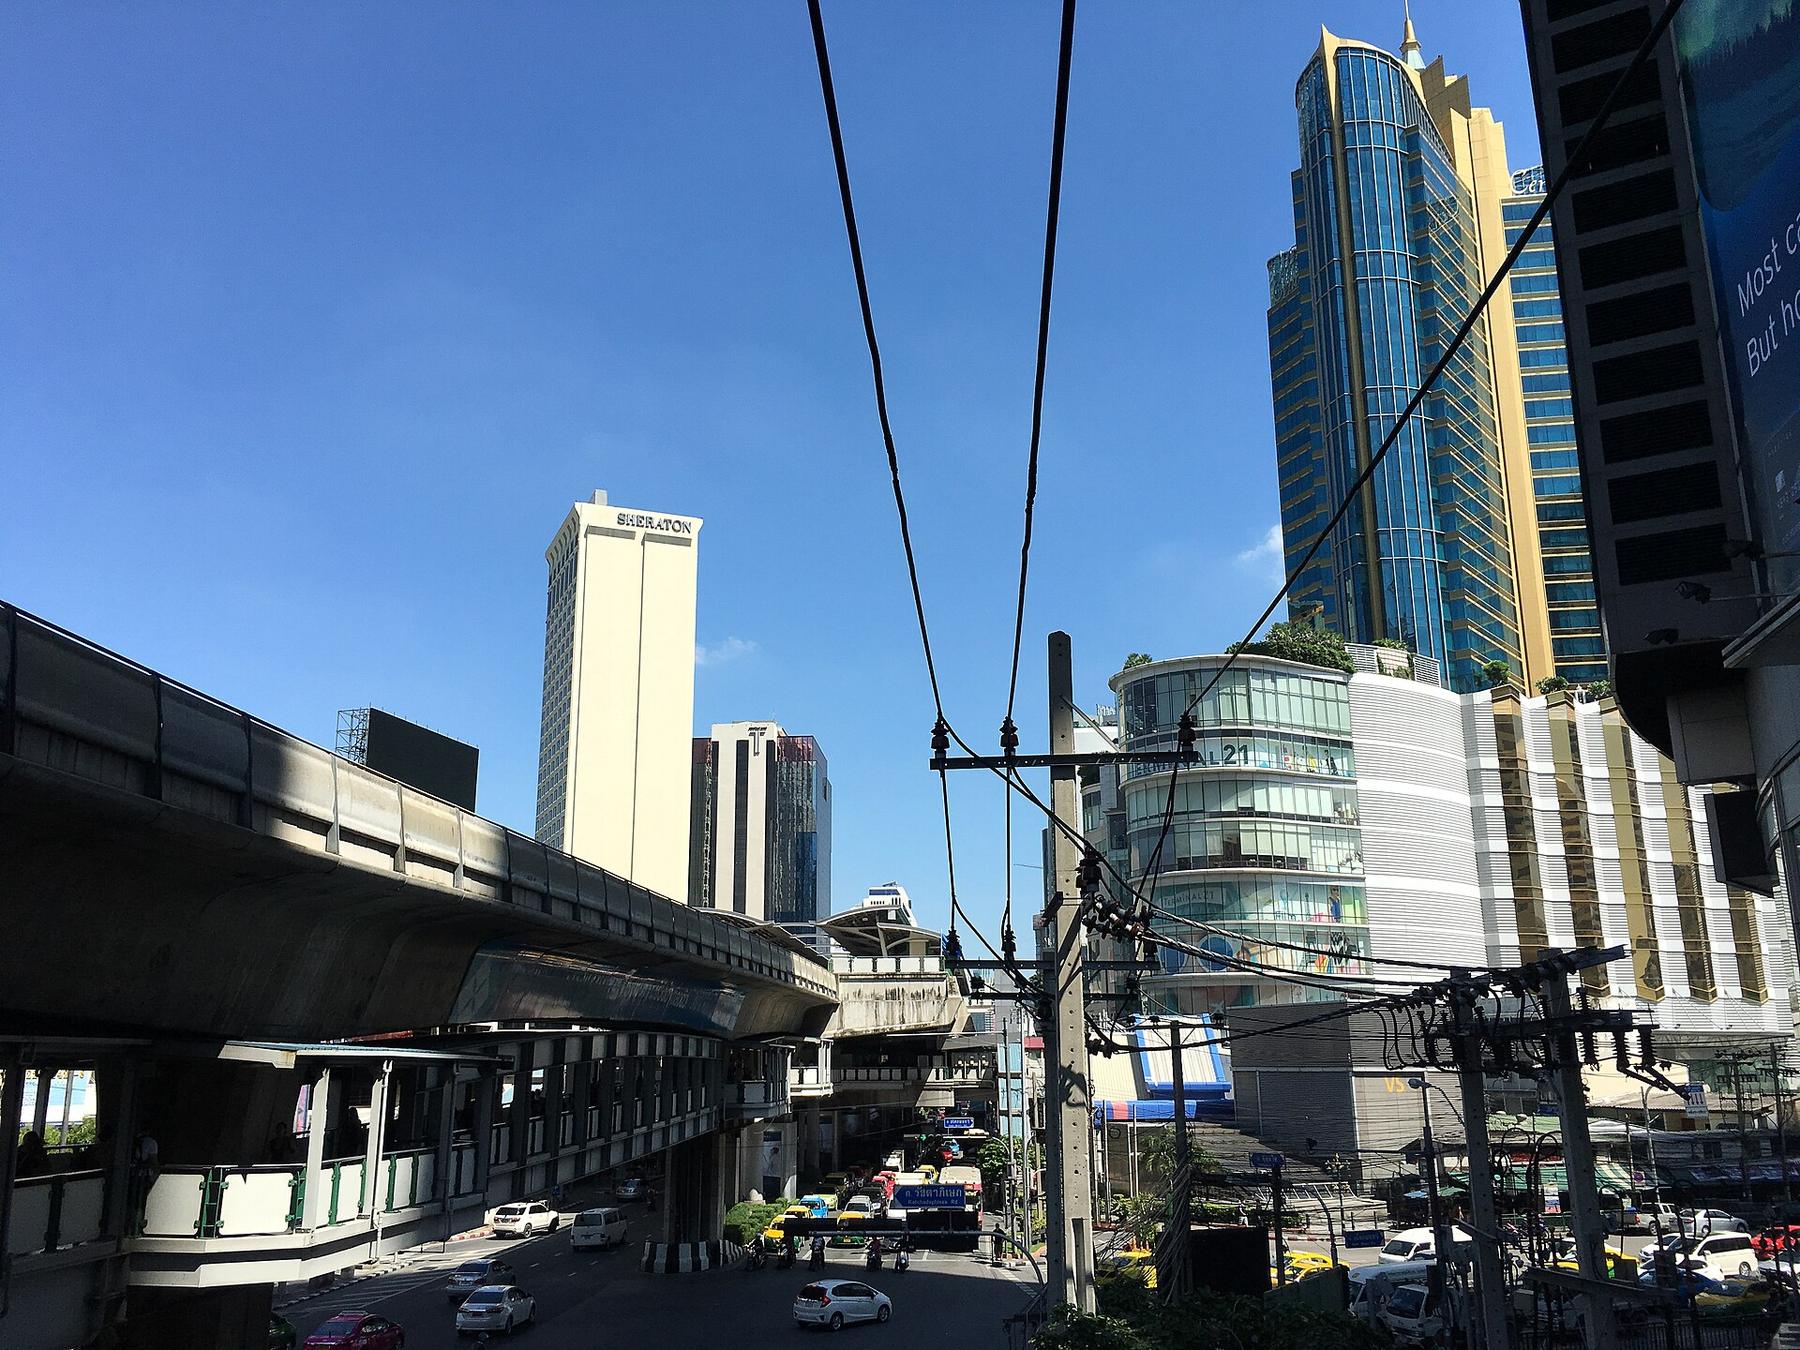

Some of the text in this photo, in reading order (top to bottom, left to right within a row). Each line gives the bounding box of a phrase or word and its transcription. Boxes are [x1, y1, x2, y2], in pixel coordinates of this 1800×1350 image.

[1737, 236, 1782, 318] Most
[1746, 313, 1779, 377] But
[617, 512, 692, 534] SHERATON
